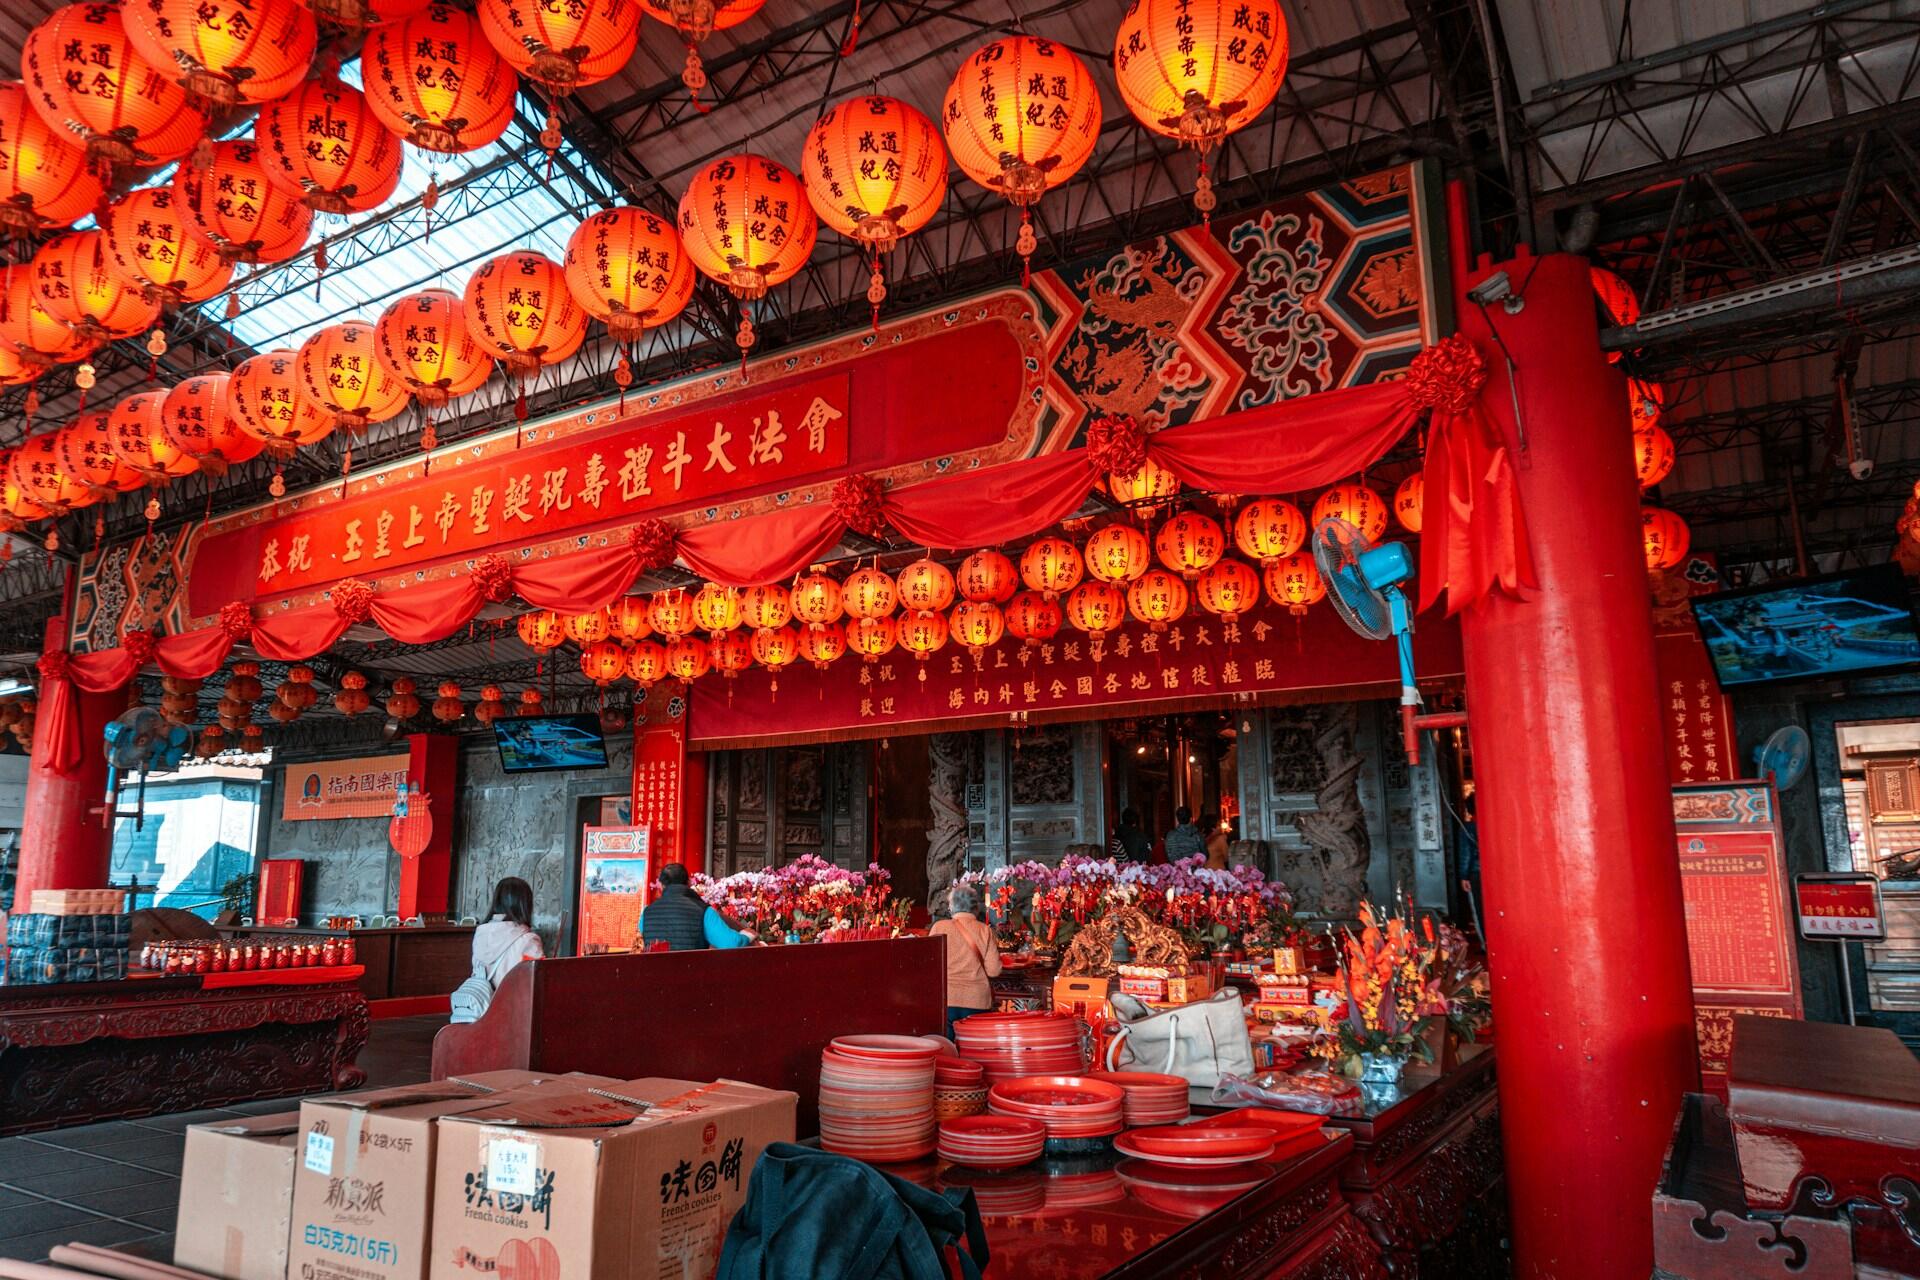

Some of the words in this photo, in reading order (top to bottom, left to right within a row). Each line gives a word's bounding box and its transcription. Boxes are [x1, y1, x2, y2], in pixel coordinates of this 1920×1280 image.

[1232, 4, 1271, 40] 成道
[63, 38, 115, 70] 成道
[415, 37, 460, 65] 成道
[1227, 36, 1269, 71] 紀念
[65, 69, 119, 99] 紀念
[415, 64, 460, 91] 紀念
[1027, 72, 1069, 101] 成道
[308, 113, 350, 142] 成道
[1026, 102, 1068, 130] 紀念
[306, 140, 349, 166] 紀念
[859, 130, 901, 153] 成道
[860, 157, 901, 181] 紀念
[218, 173, 258, 200] 成道
[216, 198, 257, 222] 紀念
[753, 194, 788, 223] 成道
[136, 219, 175, 243] 成道
[750, 220, 786, 246] 紀念
[136, 242, 175, 264] 紀念
[636, 246, 669, 272] 成道
[632, 270, 667, 293] 紀念
[508, 287, 543, 310] 成道
[506, 310, 542, 330] 紀念
[406, 325, 438, 344] 成道
[330, 353, 362, 373] 成道
[406, 346, 439, 364] 紀念
[329, 373, 362, 391] 紀念
[258, 533, 312, 583] 恭祝
[860, 695, 895, 718] 歡迎
[323, 1177, 386, 1217] 新貴派
[661, 1200, 690, 1218] French
[691, 1191, 721, 1209] cookies
[465, 1206, 492, 1223] French
[495, 1213, 529, 1229] cookies
[304, 1223, 398, 1267] 白巧克力(5斤)
